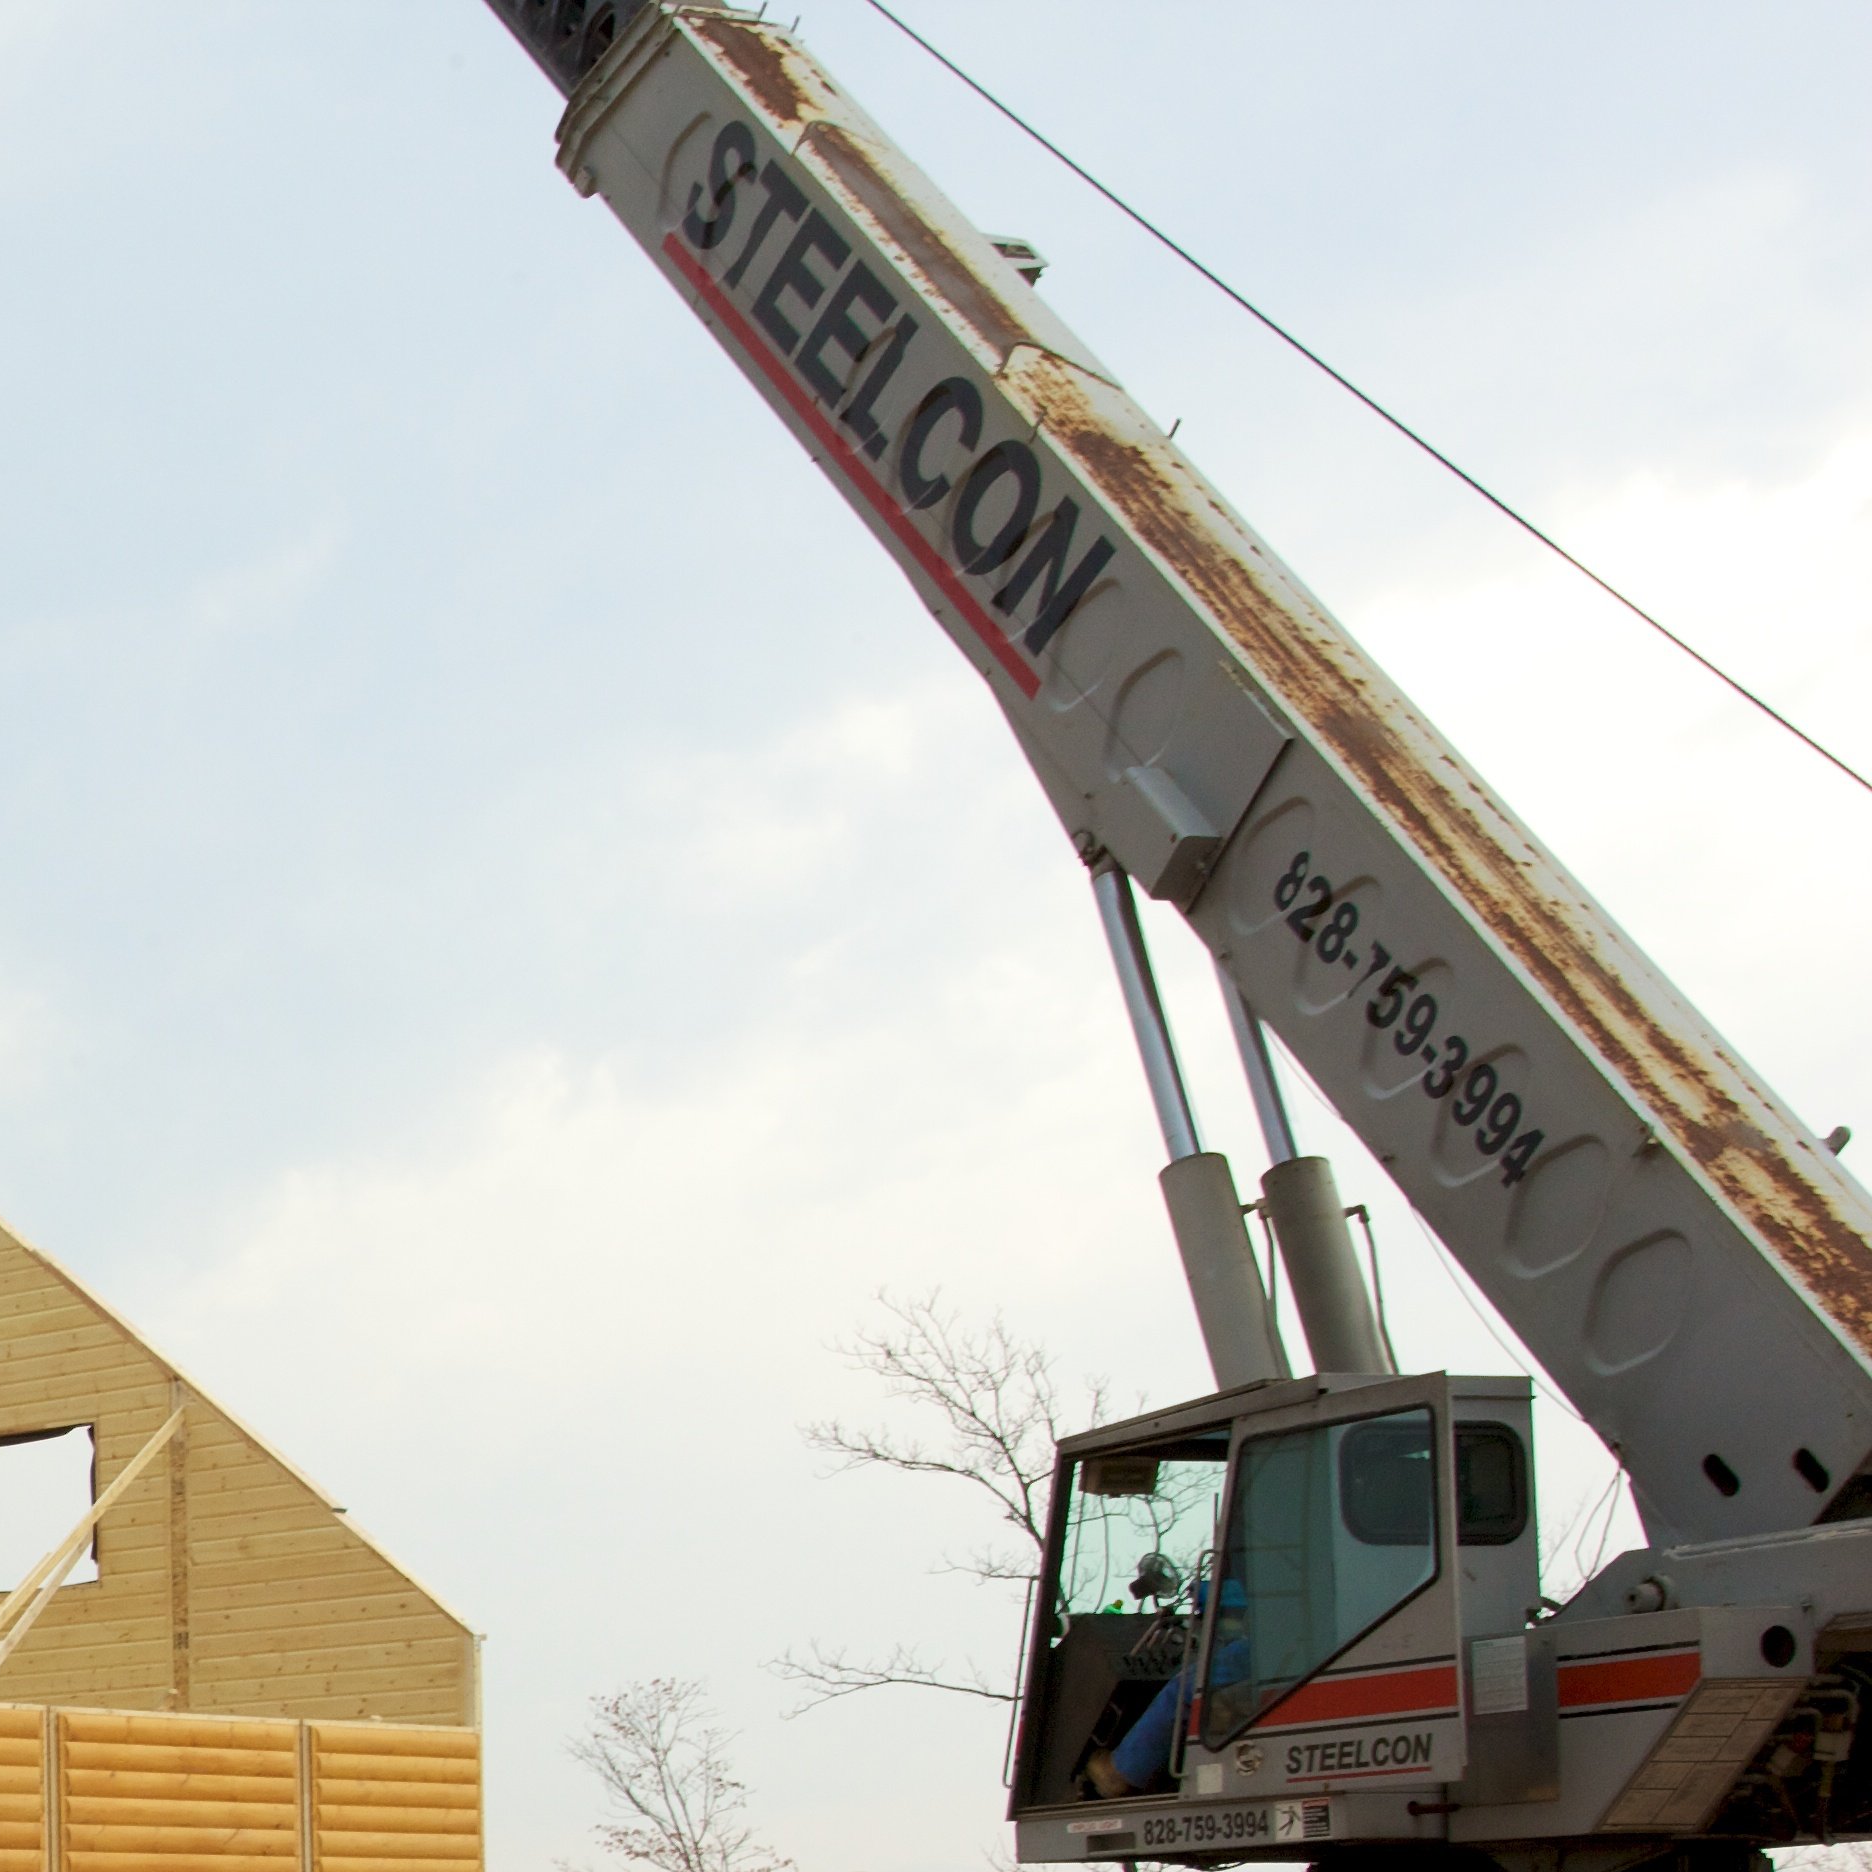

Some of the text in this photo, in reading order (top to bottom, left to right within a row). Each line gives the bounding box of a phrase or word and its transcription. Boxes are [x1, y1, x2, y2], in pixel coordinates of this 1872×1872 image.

[683, 119, 1116, 658] STEELCON
[1272, 849, 1545, 1188] 828-759-3994
[1143, 1809, 1270, 1846] 828-759-3994
[1285, 1732, 1434, 1775] STEELCON
